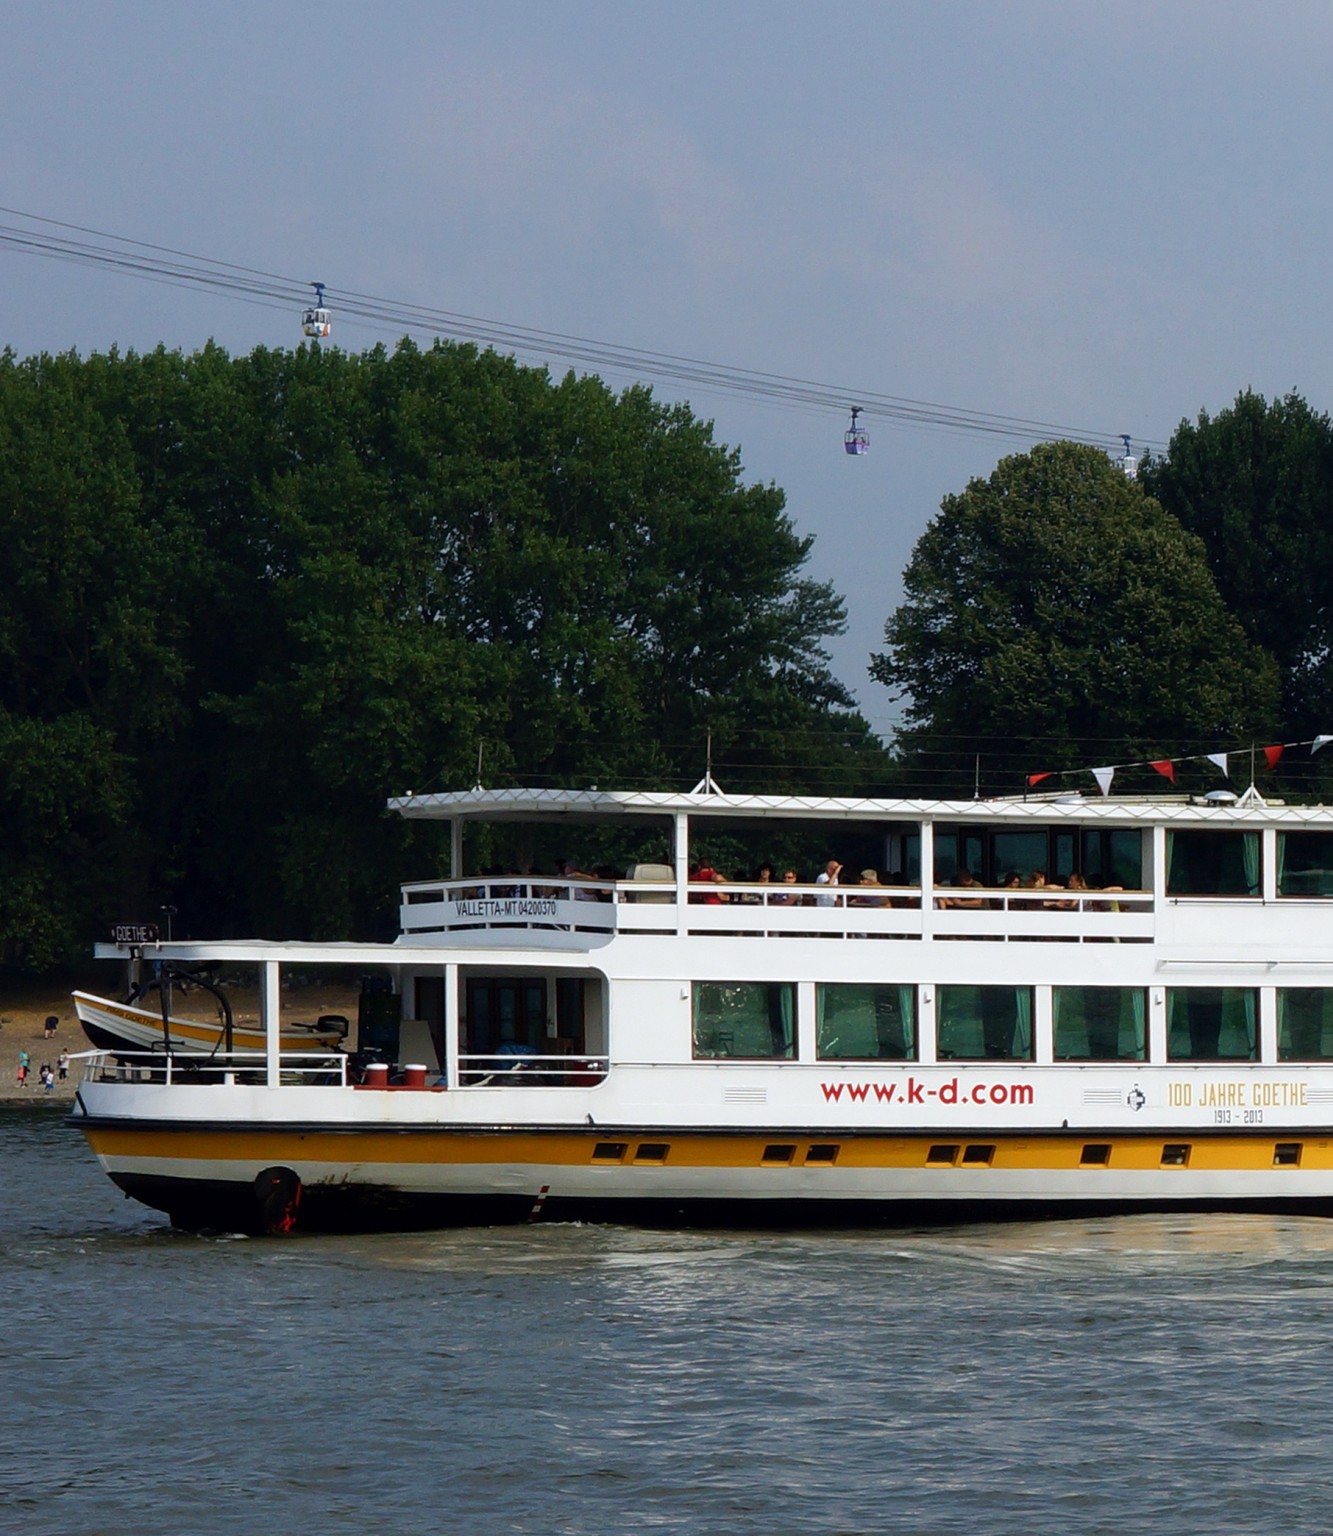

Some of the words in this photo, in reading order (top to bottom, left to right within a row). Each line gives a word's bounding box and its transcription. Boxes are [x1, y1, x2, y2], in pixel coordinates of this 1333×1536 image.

[456, 901, 518, 916] VALLETTA-MT
[518, 900, 556, 916] 04200370
[116, 926, 148, 941] GOETHE
[820, 1077, 1034, 1105] www.k-d.com
[1168, 1083, 1192, 1107] 100
[1199, 1083, 1246, 1107] JAHRE
[1252, 1083, 1308, 1107] GOETHE
[1214, 1109, 1231, 1124] 1913
[1243, 1109, 1263, 1124] 2013
